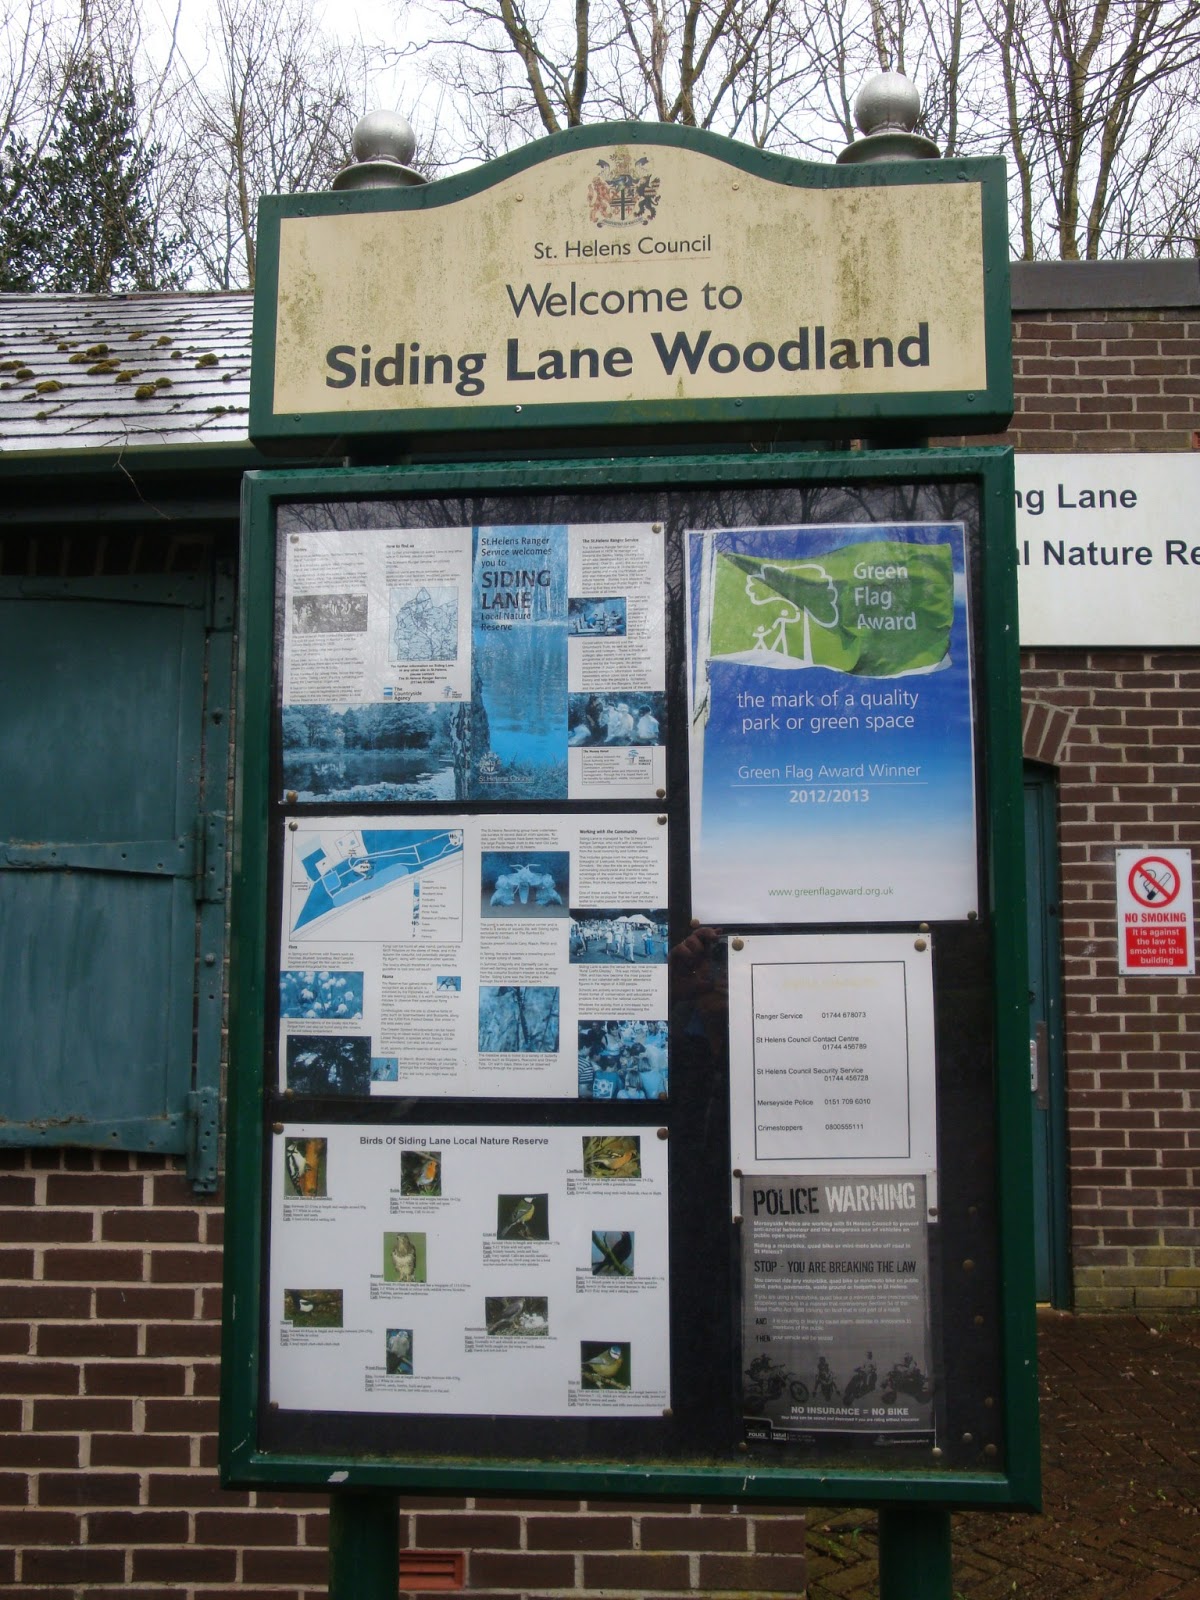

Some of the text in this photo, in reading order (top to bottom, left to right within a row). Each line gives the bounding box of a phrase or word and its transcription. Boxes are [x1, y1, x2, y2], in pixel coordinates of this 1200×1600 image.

[533, 234, 712, 260] St. Helens Council
[505, 281, 743, 318] Welcome to
[325, 322, 930, 398] Siding Lane Woodland
[1058, 484, 1138, 508] Lane
[522, 536, 550, 546] Ranger
[482, 548, 552, 556] Service welcomes
[1016, 540, 1030, 566] l
[1043, 540, 1153, 566] Nature
[482, 570, 551, 588] SIDING
[853, 562, 908, 580] Green
[482, 592, 531, 609] LANE
[854, 587, 893, 610] Flag
[857, 612, 917, 630] Award
[737, 689, 919, 711] the mark of a quality
[742, 714, 915, 734] park or green space
[738, 763, 921, 782] Green Flag Award Winner
[789, 788, 870, 804] 2012/2013
[768, 886, 894, 898] www.greenflagaward.org.uk
[1125, 912, 1187, 923] NO SMOKING
[1150, 928, 1179, 937] against
[1141, 957, 1174, 965] building
[813, 1067, 838, 1075] Security
[757, 1099, 793, 1108] Merseyside
[758, 1124, 803, 1133] Crimestoppers
[360, 1137, 383, 1145] Birds
[386, 1137, 396, 1145] Of
[398, 1137, 426, 1146] Siding
[753, 1182, 916, 1216] POLICE WARNING
[754, 1261, 777, 1273] STOP
[787, 1261, 805, 1273] YOU
[808, 1261, 826, 1273] ARE
[829, 1261, 874, 1273] BREAKING
[877, 1261, 894, 1273] THE
[897, 1261, 917, 1273] LAW
[807, 1407, 860, 1415] INSURANCE
